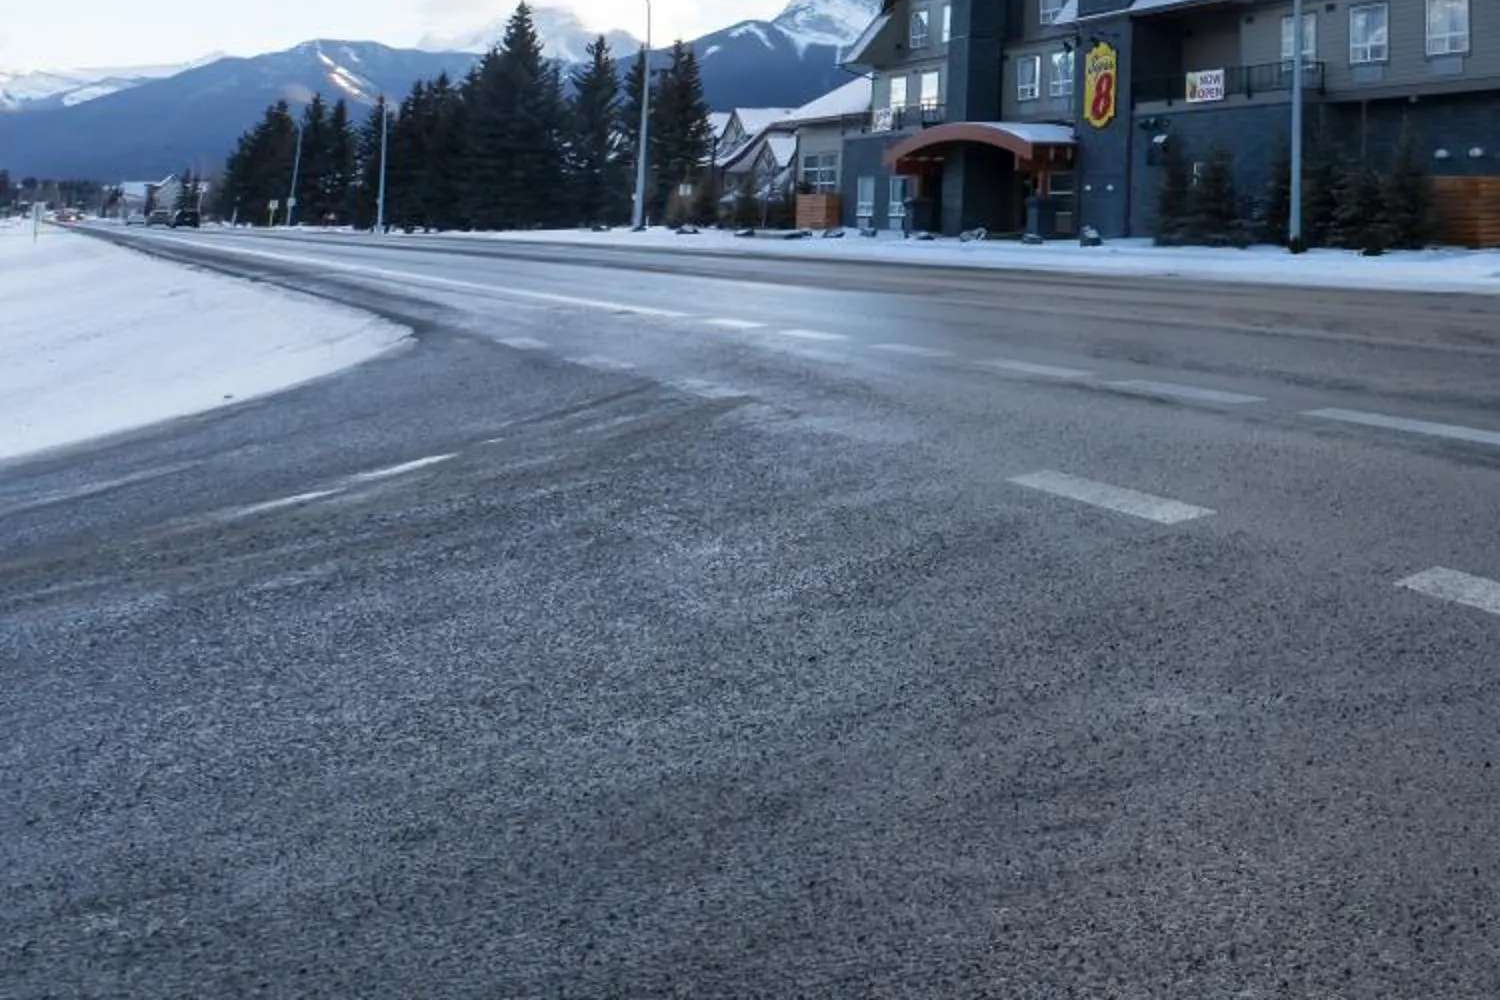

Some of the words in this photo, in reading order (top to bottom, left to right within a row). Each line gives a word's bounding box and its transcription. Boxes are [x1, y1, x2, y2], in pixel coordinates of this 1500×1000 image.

[1200, 74, 1221, 85] NOW
[1092, 73, 1113, 120] 8
[1197, 87, 1223, 98] OPEN
